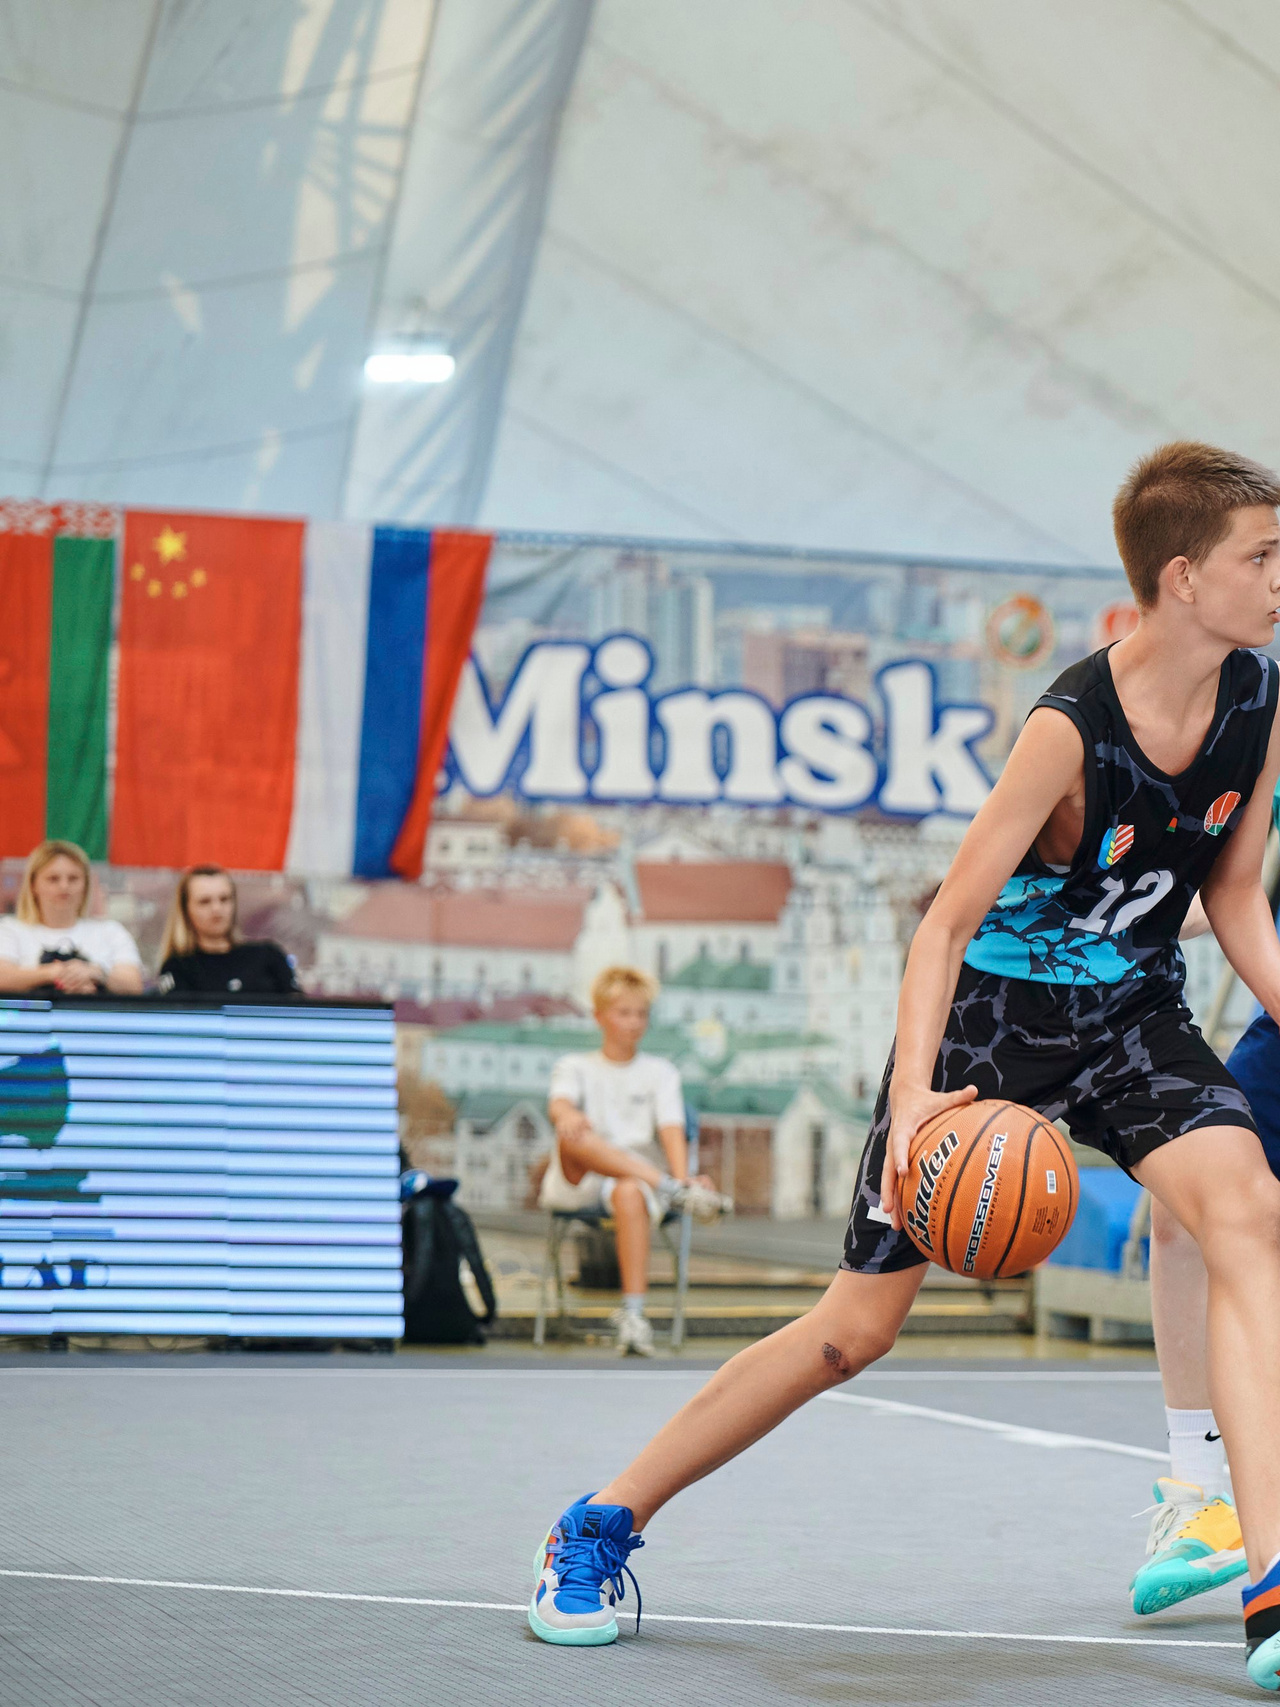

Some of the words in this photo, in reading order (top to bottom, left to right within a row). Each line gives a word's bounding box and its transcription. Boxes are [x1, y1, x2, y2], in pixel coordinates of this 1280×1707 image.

[440, 632, 996, 816] Minsk
[1068, 869, 1174, 935] 12
[907, 1130, 960, 1254] Baden
[962, 1132, 1008, 1273] CROSSOVER
